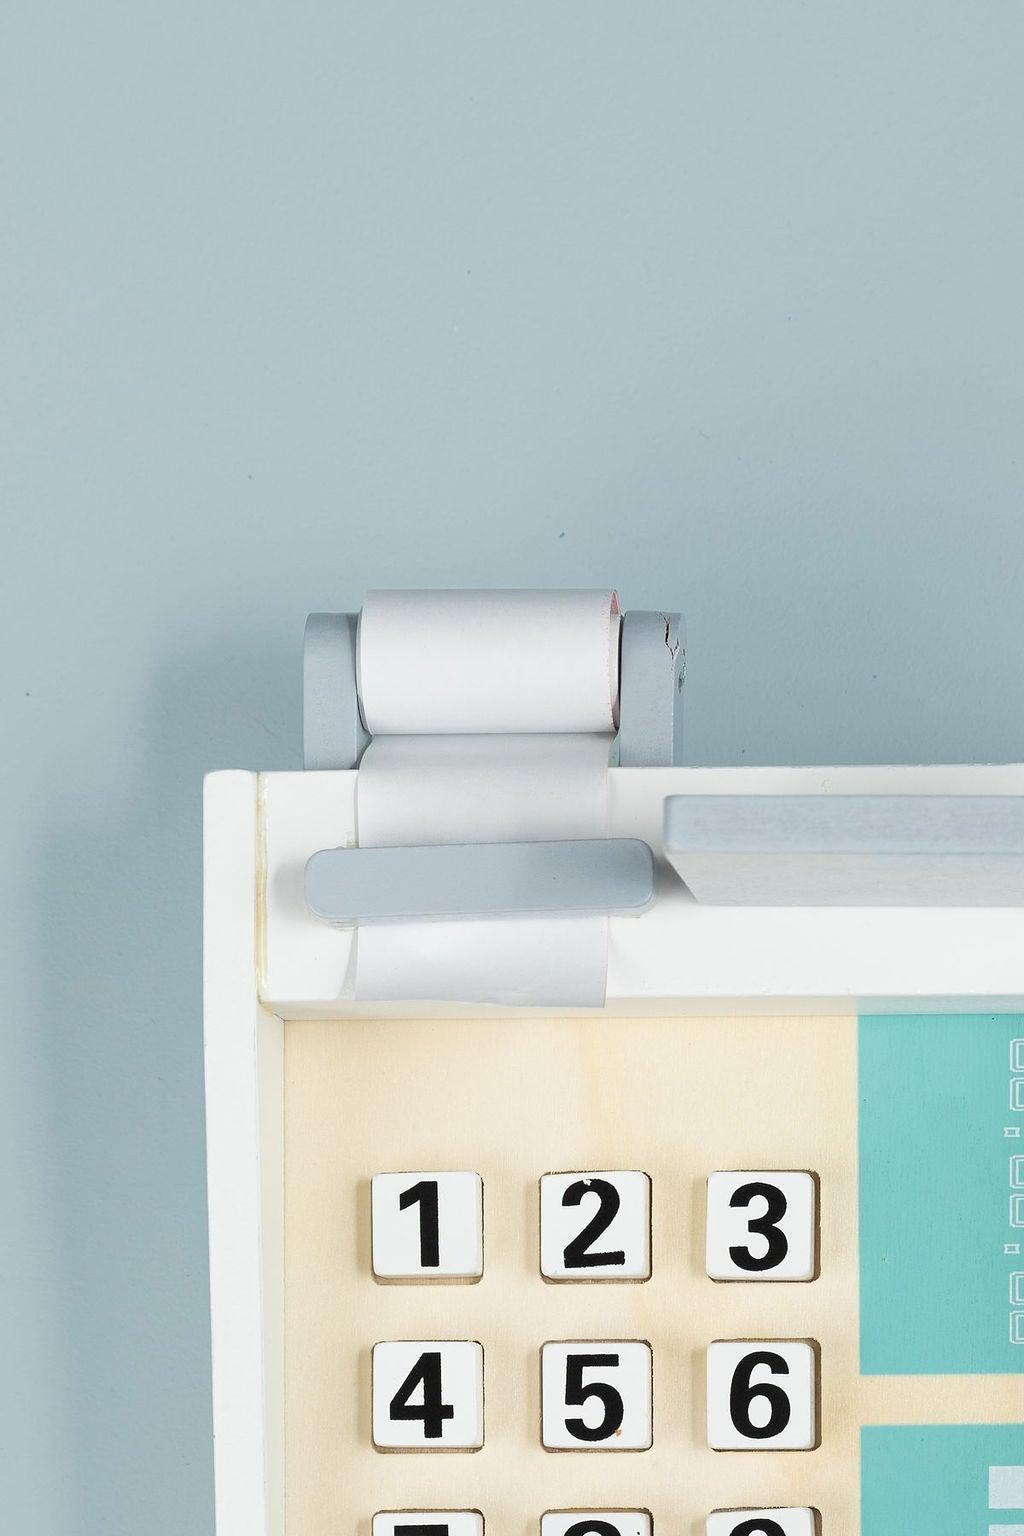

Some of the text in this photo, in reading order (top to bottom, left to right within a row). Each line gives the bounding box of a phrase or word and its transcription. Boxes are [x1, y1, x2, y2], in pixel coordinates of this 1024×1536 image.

[400, 1179, 788, 1271] 1 2 3
[390, 1351, 790, 1441] 4 5 6
